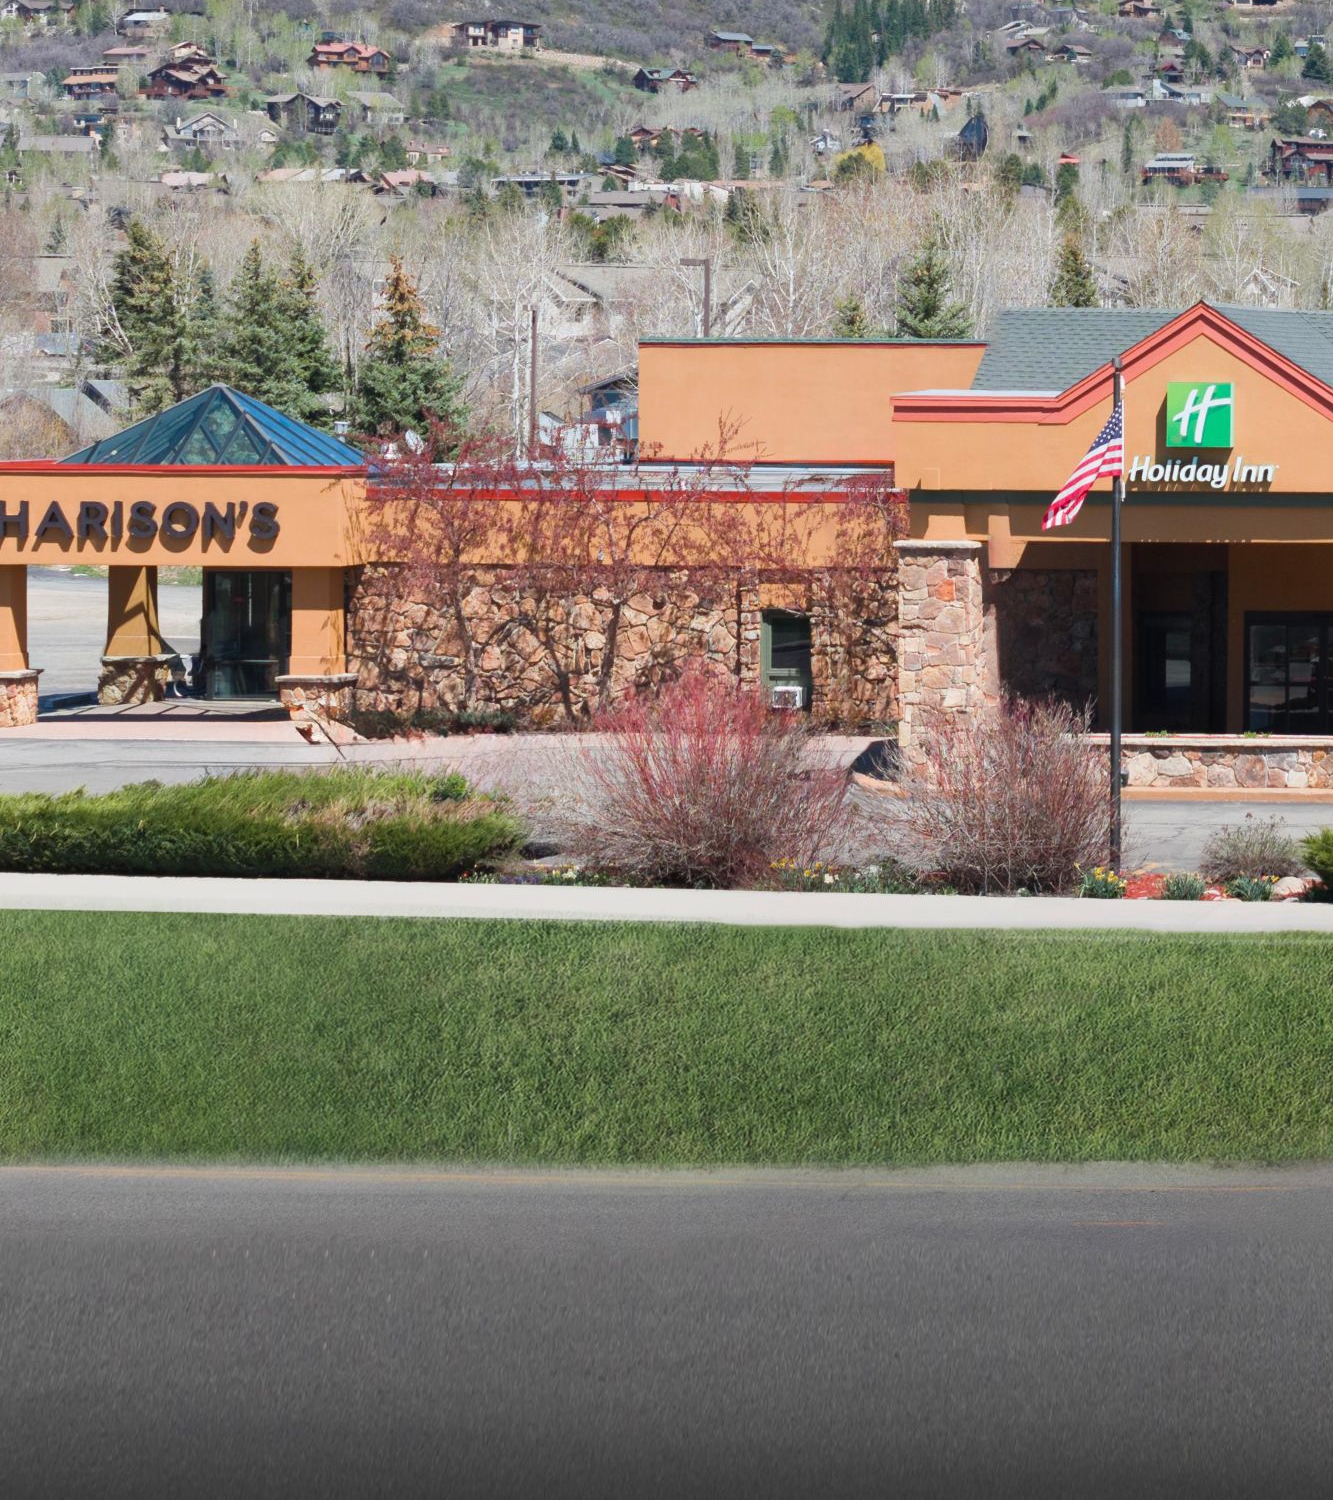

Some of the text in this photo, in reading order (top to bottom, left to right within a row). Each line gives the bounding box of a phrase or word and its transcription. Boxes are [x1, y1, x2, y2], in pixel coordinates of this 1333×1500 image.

[1128, 455, 1275, 489] Holiday Inn
[0, 500, 280, 539] HARISON'S
